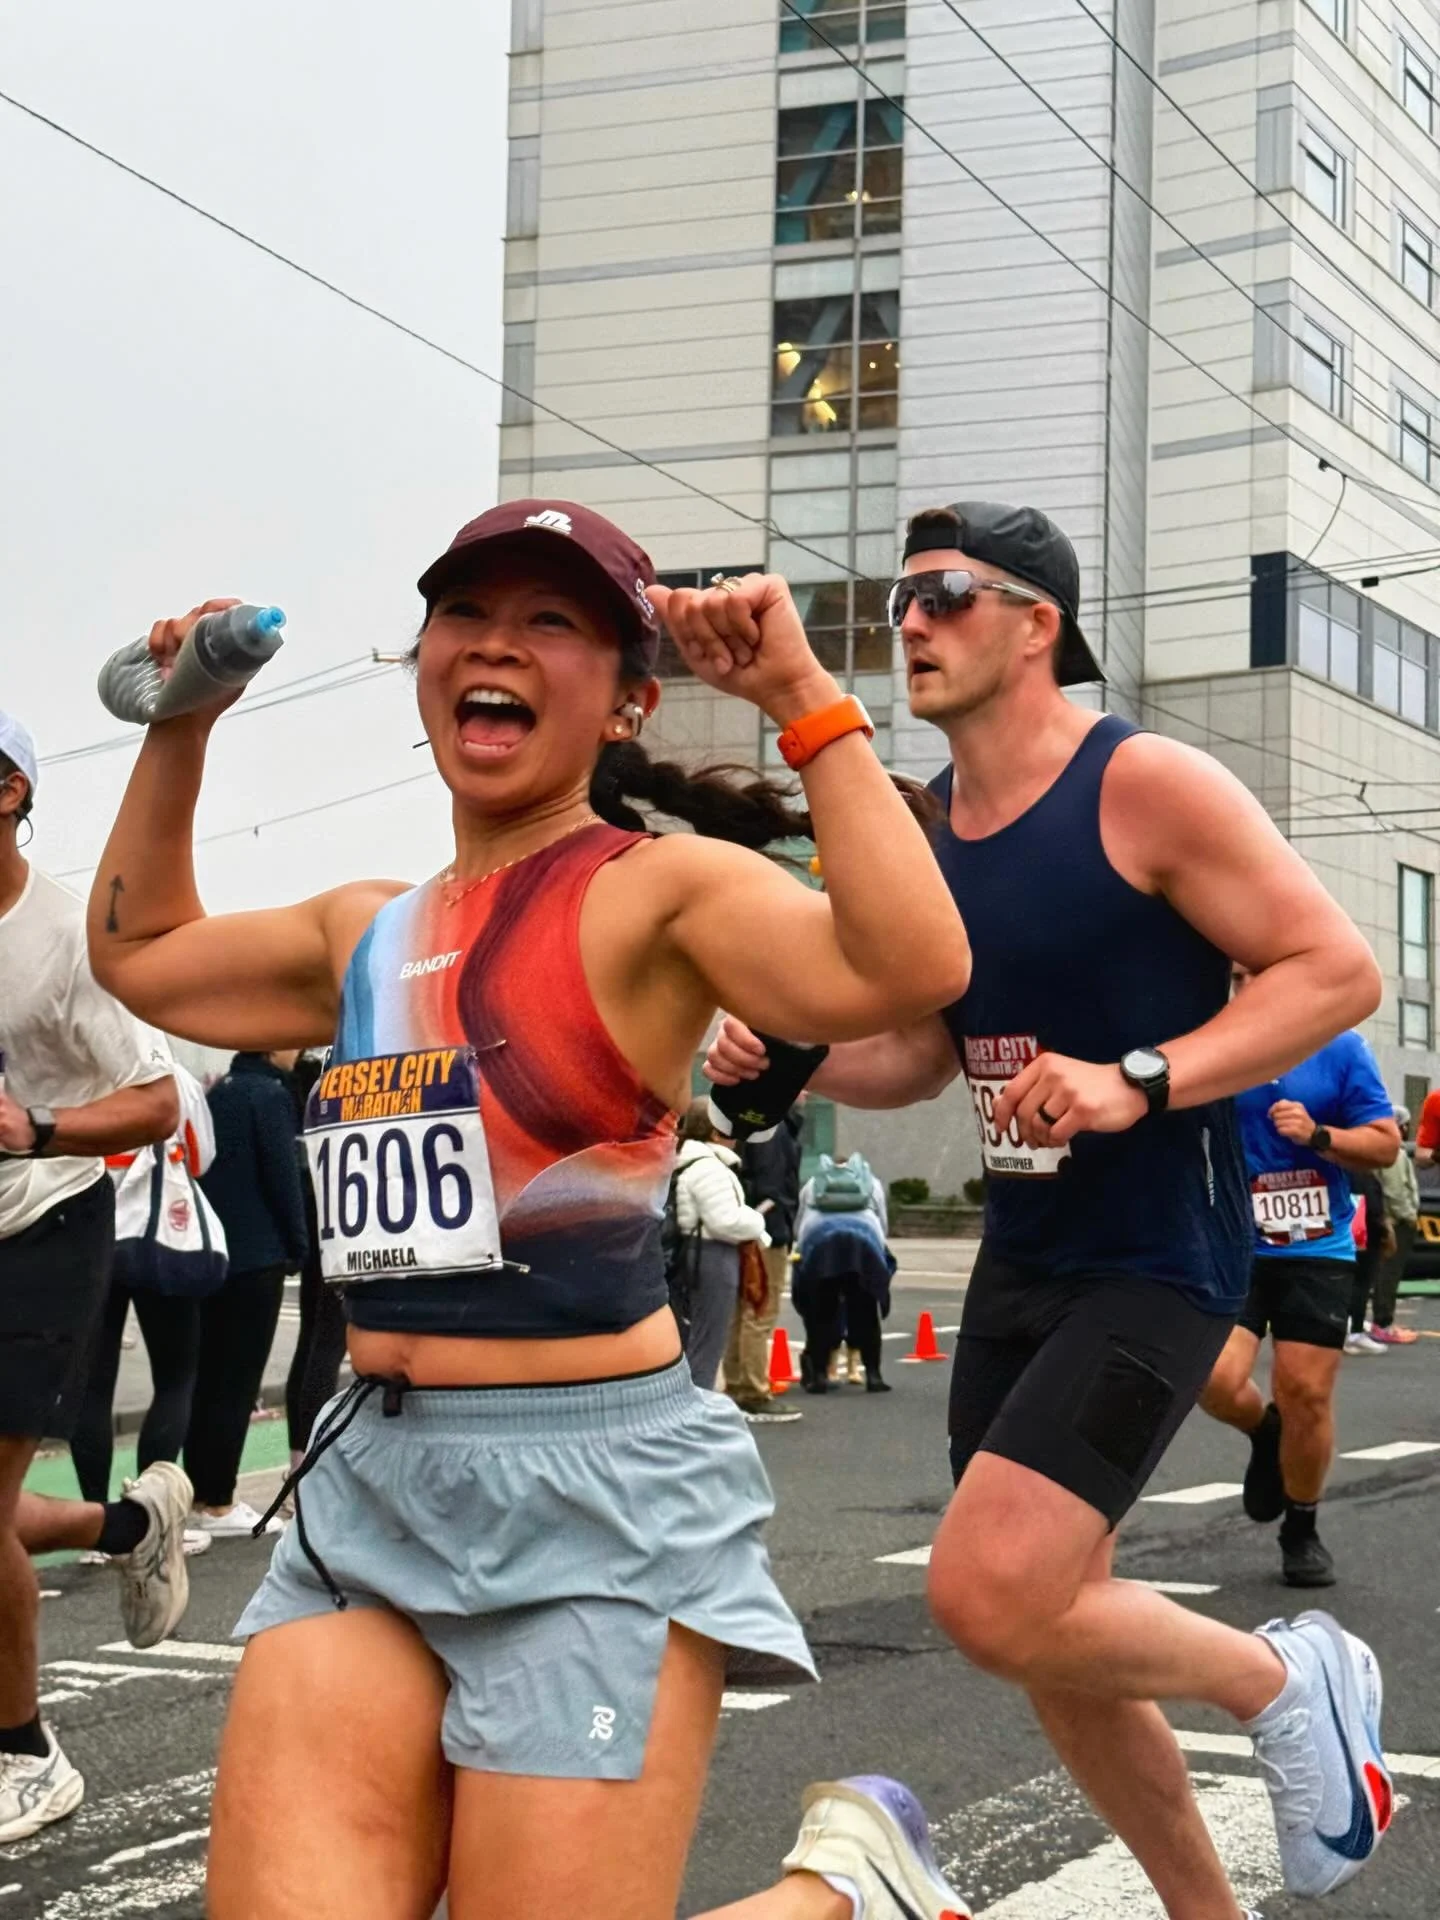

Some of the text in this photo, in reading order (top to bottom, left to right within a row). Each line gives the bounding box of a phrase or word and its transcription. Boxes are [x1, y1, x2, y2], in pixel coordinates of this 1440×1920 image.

[398, 949, 462, 979] BANDIT
[998, 1035, 1037, 1060] CITY
[319, 1049, 458, 1100] JERSEY CITY
[316, 1122, 474, 1241] 1606
[1258, 1190, 1326, 1222] 10811
[346, 1247, 418, 1272] MICHAELA
